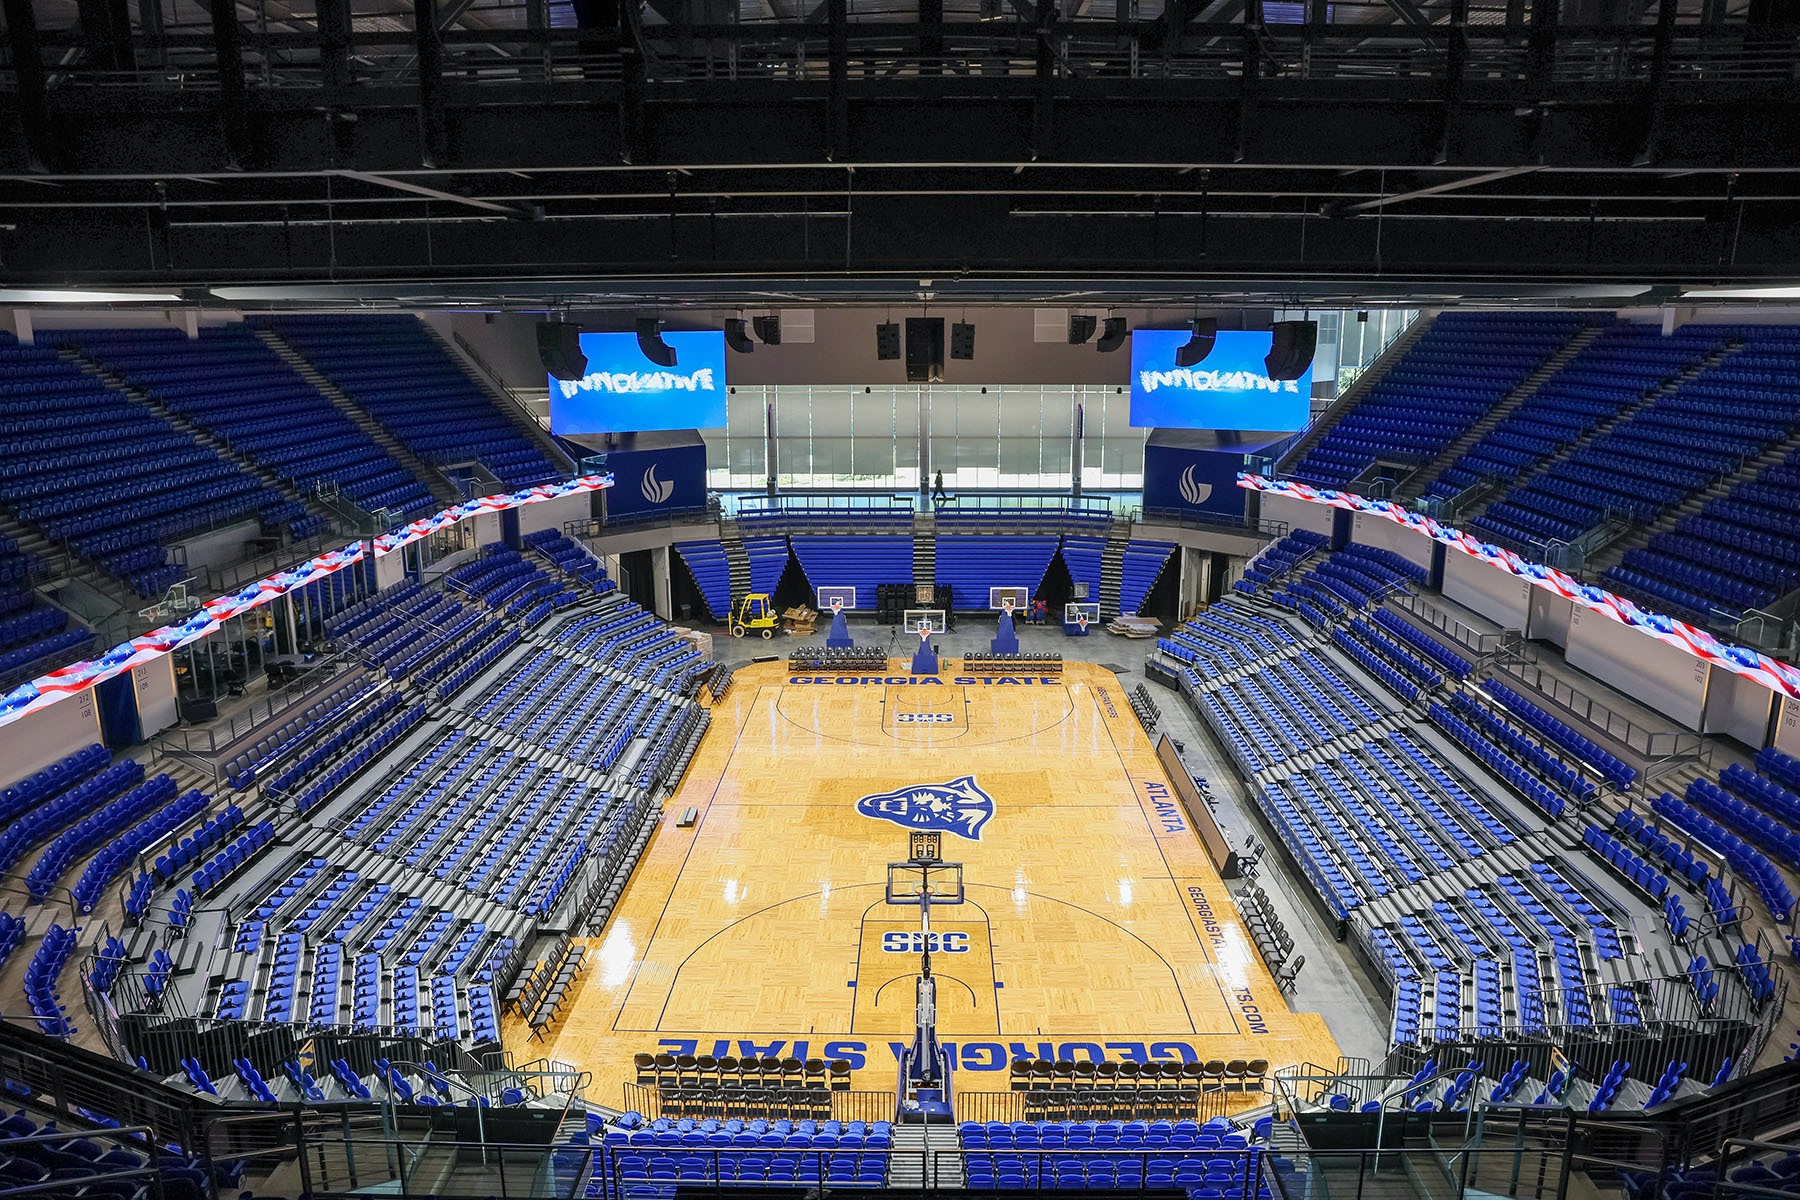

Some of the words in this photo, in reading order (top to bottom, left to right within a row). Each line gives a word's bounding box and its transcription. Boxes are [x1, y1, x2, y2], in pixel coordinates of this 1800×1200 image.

[789, 676, 944, 685] GEORGIA
[954, 676, 1062, 685] STATE
[79, 693, 89, 704] 212
[1787, 700, 1799, 711] 204
[1786, 716, 1797, 728] 103
[1143, 782, 1186, 833] ATLANTA
[882, 931, 970, 953] SBC
[1187, 886, 1269, 1034] GEORGIASTATS.COM
